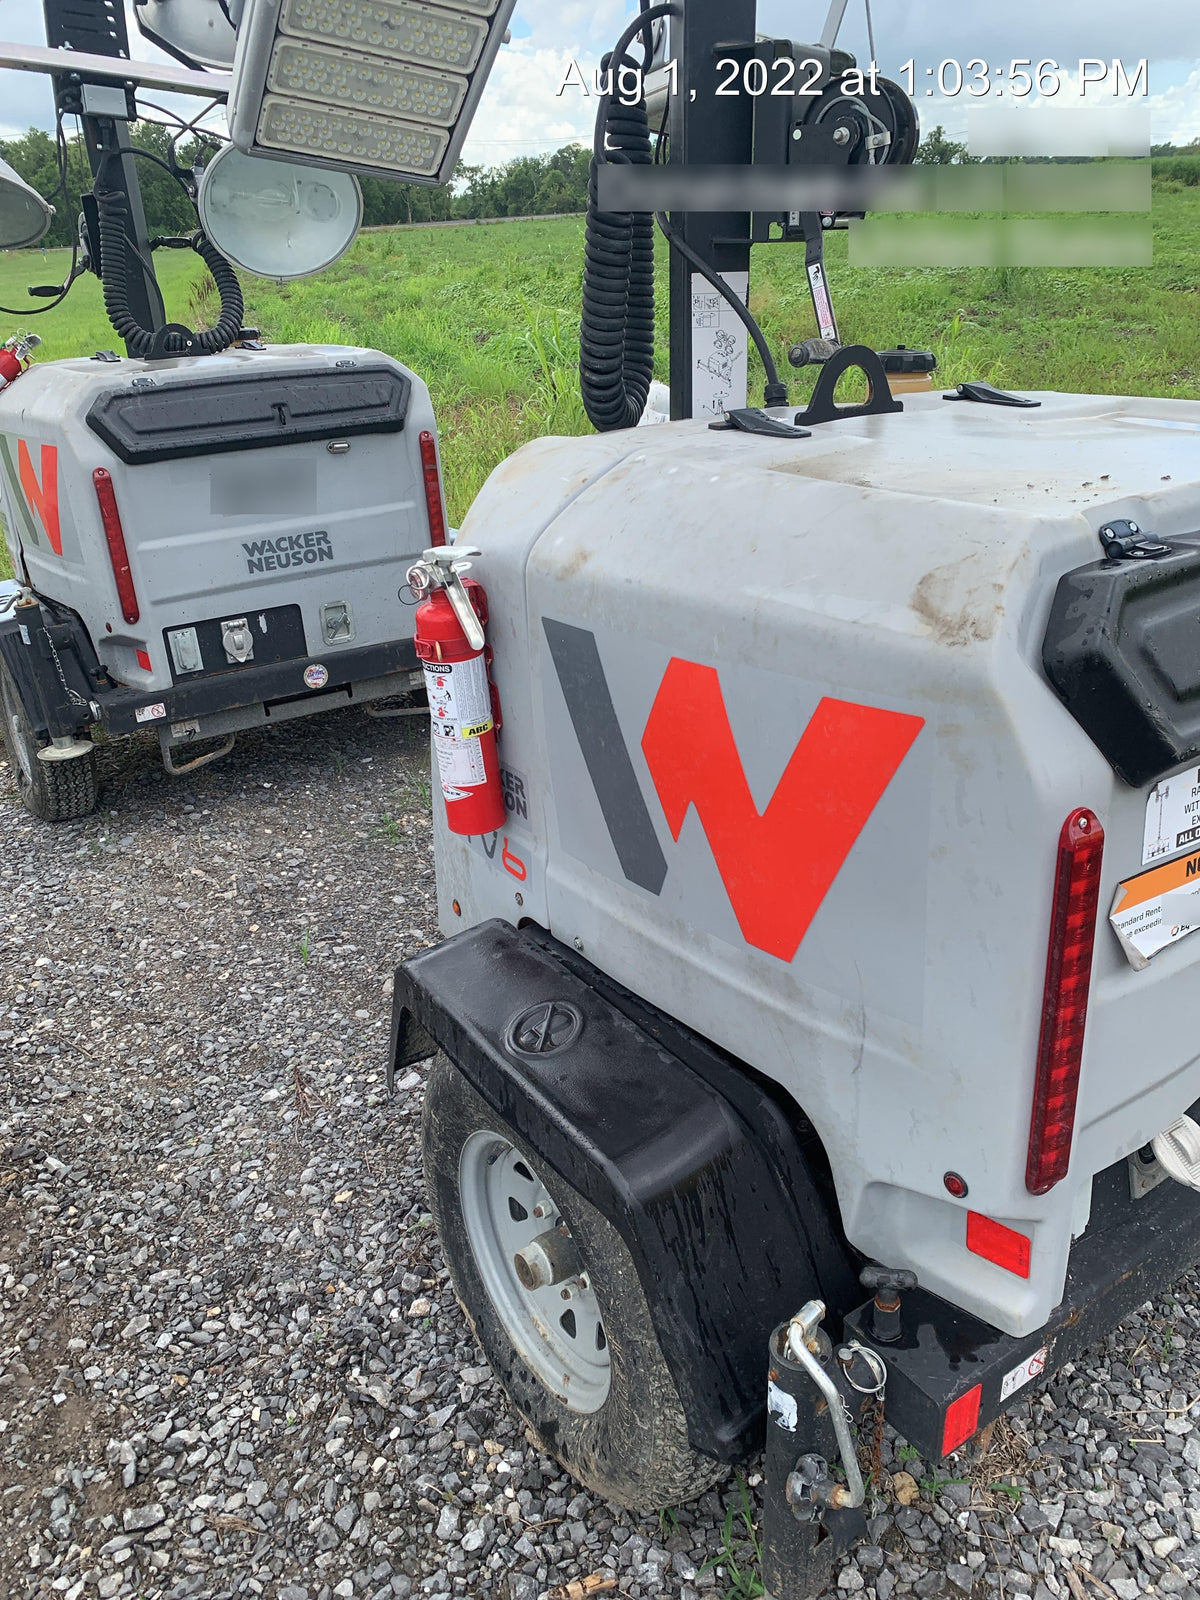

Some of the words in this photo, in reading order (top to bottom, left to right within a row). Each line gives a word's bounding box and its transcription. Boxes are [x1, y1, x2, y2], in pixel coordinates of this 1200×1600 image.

[241, 530, 332, 557] WACKER
[246, 545, 335, 575] NEUSON
[468, 723, 489, 736] ABC
[1178, 830, 1194, 845] ALL
[1145, 905, 1163, 919] Rent
